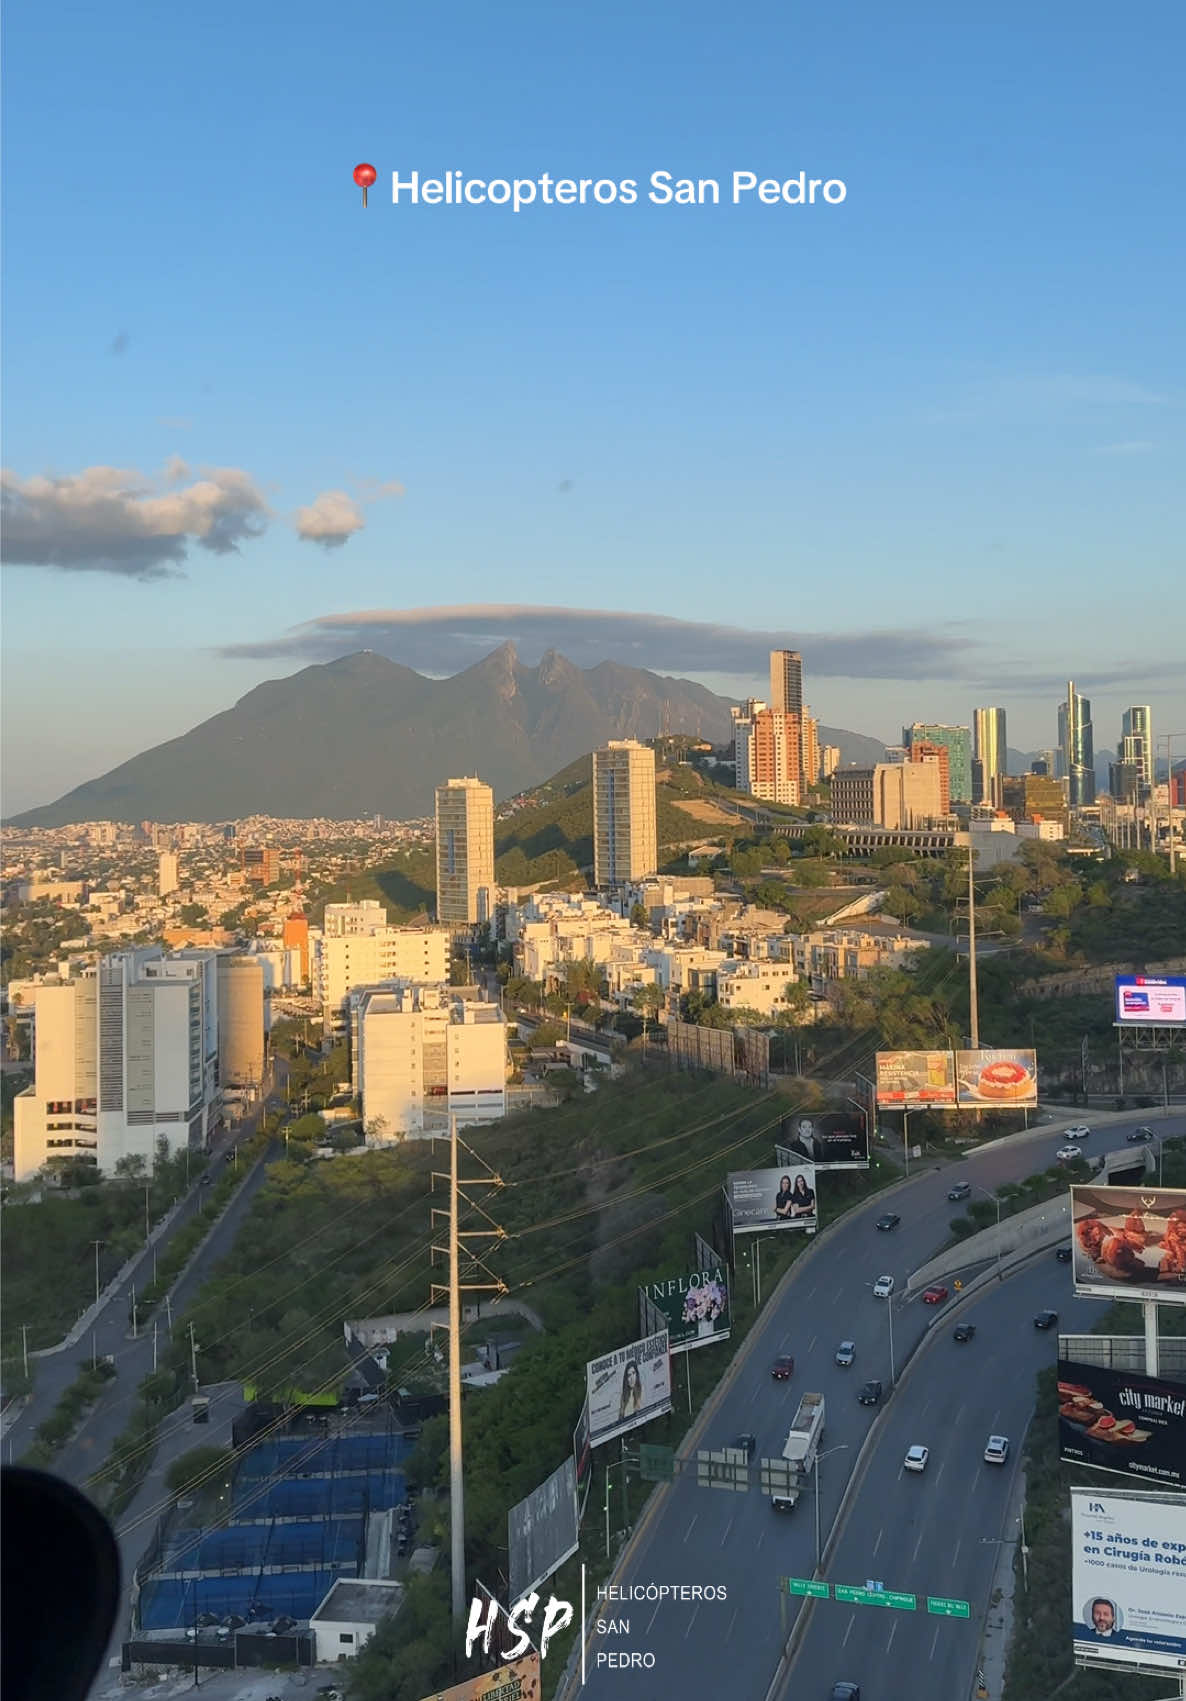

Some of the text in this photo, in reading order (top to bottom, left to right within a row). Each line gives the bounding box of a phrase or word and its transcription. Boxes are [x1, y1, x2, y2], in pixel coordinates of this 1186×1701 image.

[1118, 1387, 1142, 1410] city
[1143, 1394, 1185, 1417] market
[1128, 1462, 1180, 1479] citymarket.com.mx
[1083, 1530, 1104, 1541] +15
[1106, 1532, 1138, 1546] años
[1141, 1537, 1159, 1549] de
[1083, 1545, 1100, 1555] en
[1103, 1546, 1151, 1562] Cirugía
